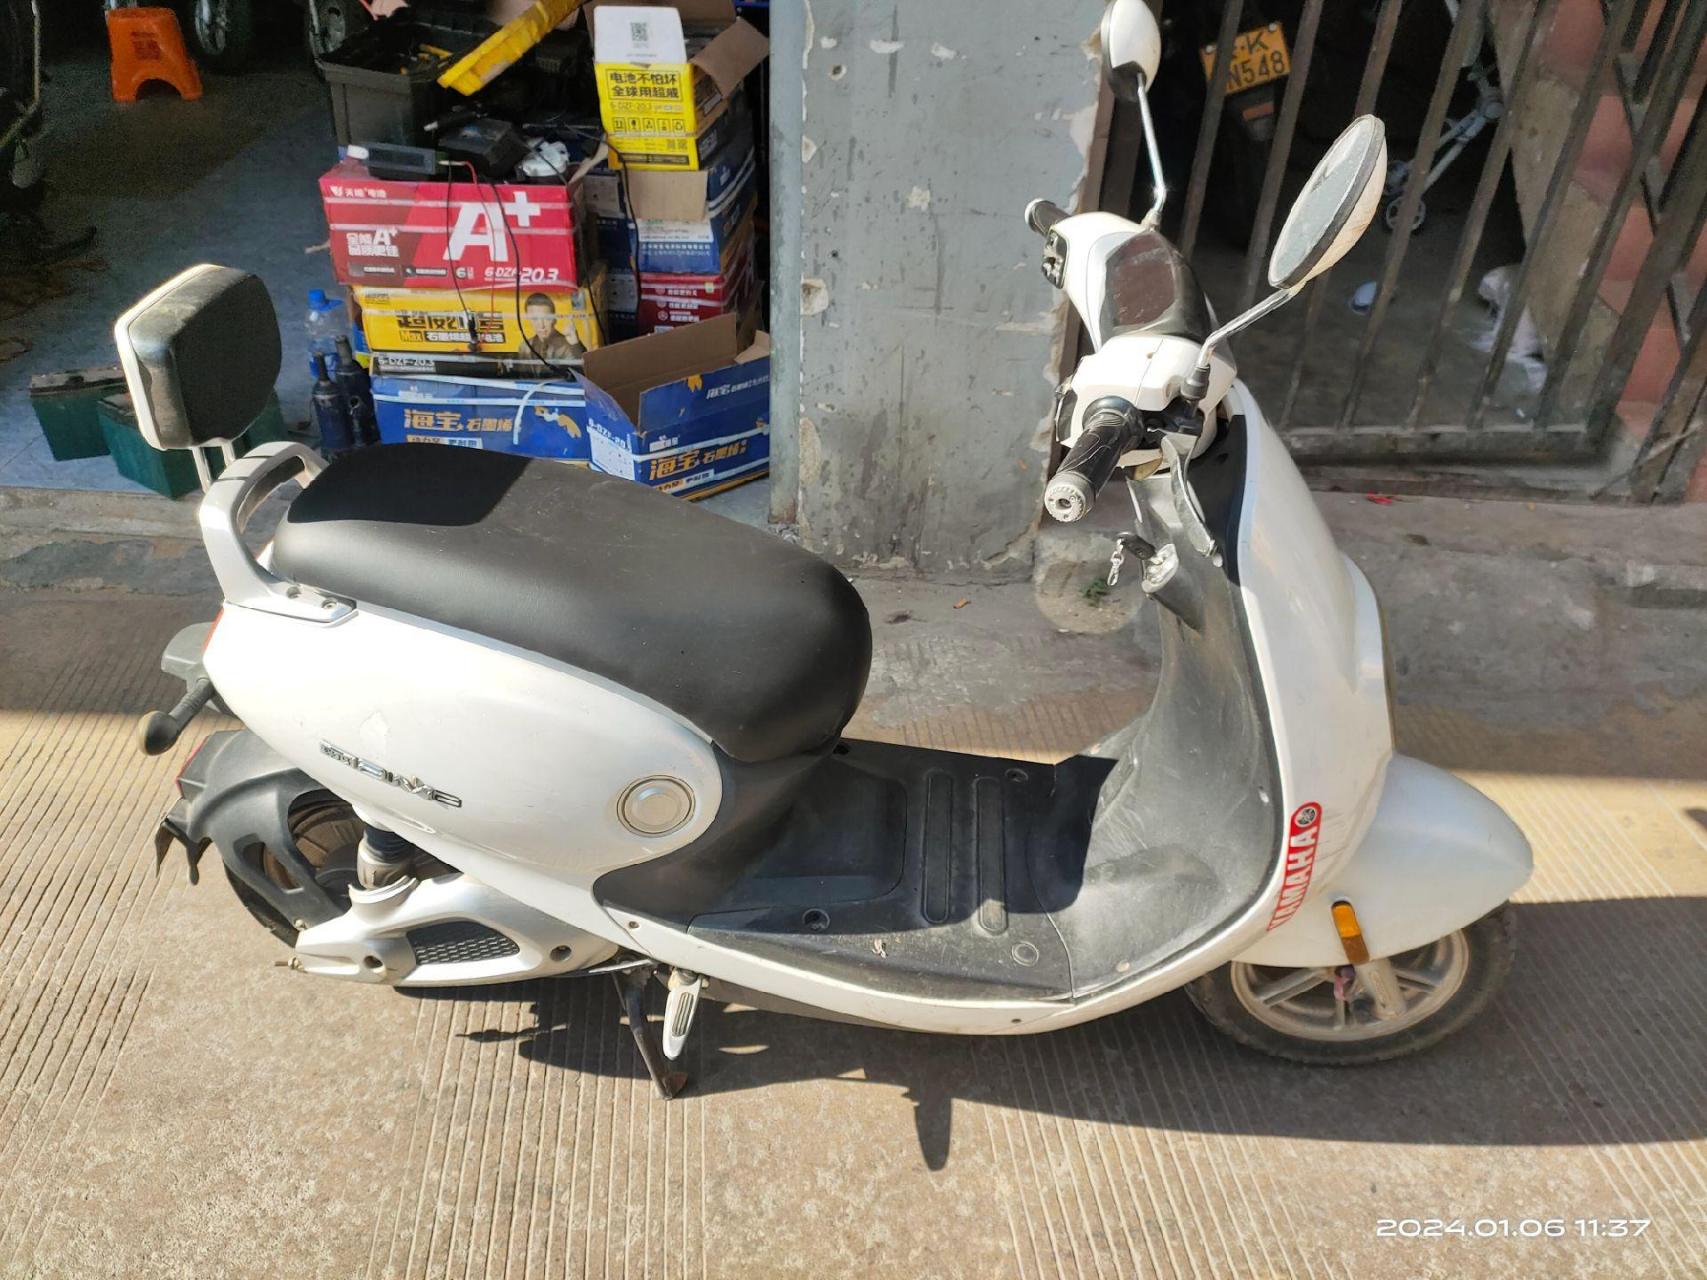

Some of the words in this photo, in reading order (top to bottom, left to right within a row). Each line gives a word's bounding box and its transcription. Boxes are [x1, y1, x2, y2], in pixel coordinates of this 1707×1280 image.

[610, 72, 676, 84] 电池不怕坏
[611, 86, 680, 98] 全球用超威
[404, 408, 463, 432] 海宝
[649, 448, 701, 480] 海宝
